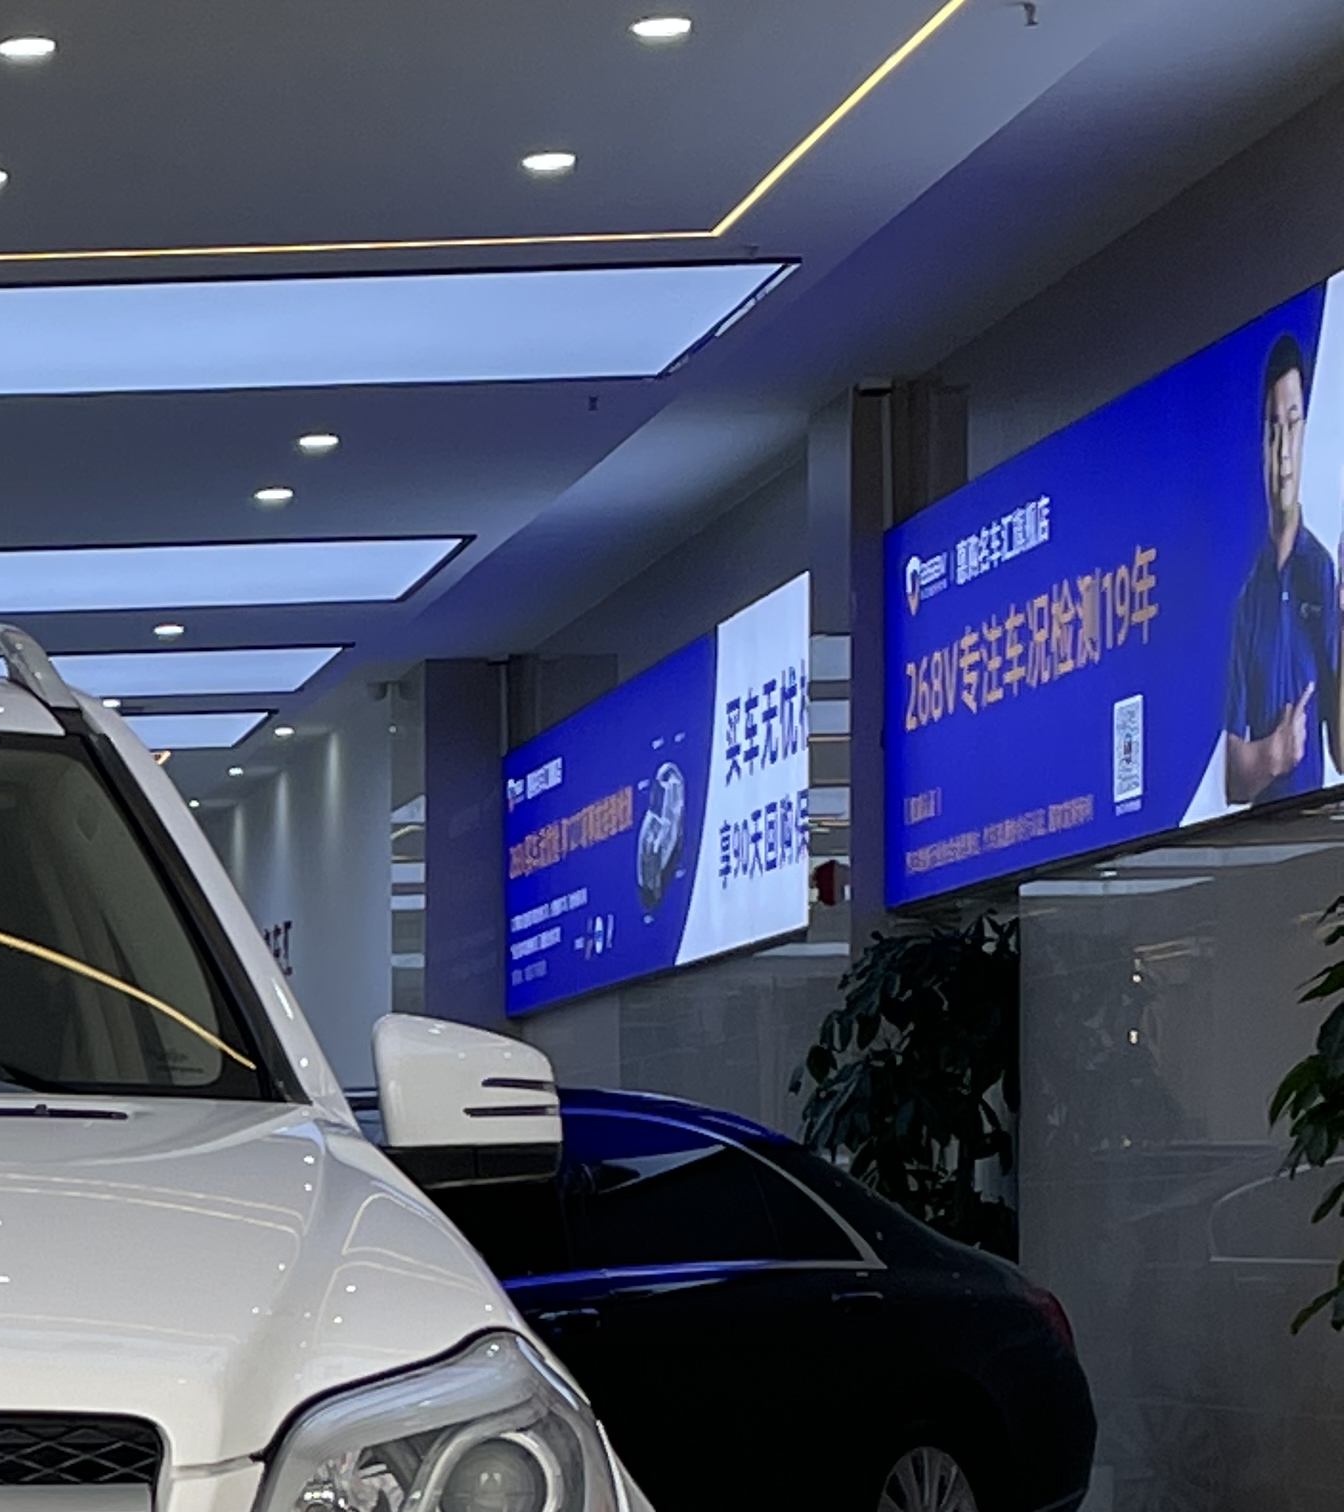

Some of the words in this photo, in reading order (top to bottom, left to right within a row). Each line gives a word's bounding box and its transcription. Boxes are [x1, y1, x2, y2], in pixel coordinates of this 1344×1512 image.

[905, 545, 1159, 731] 268V专注车况检测19年
